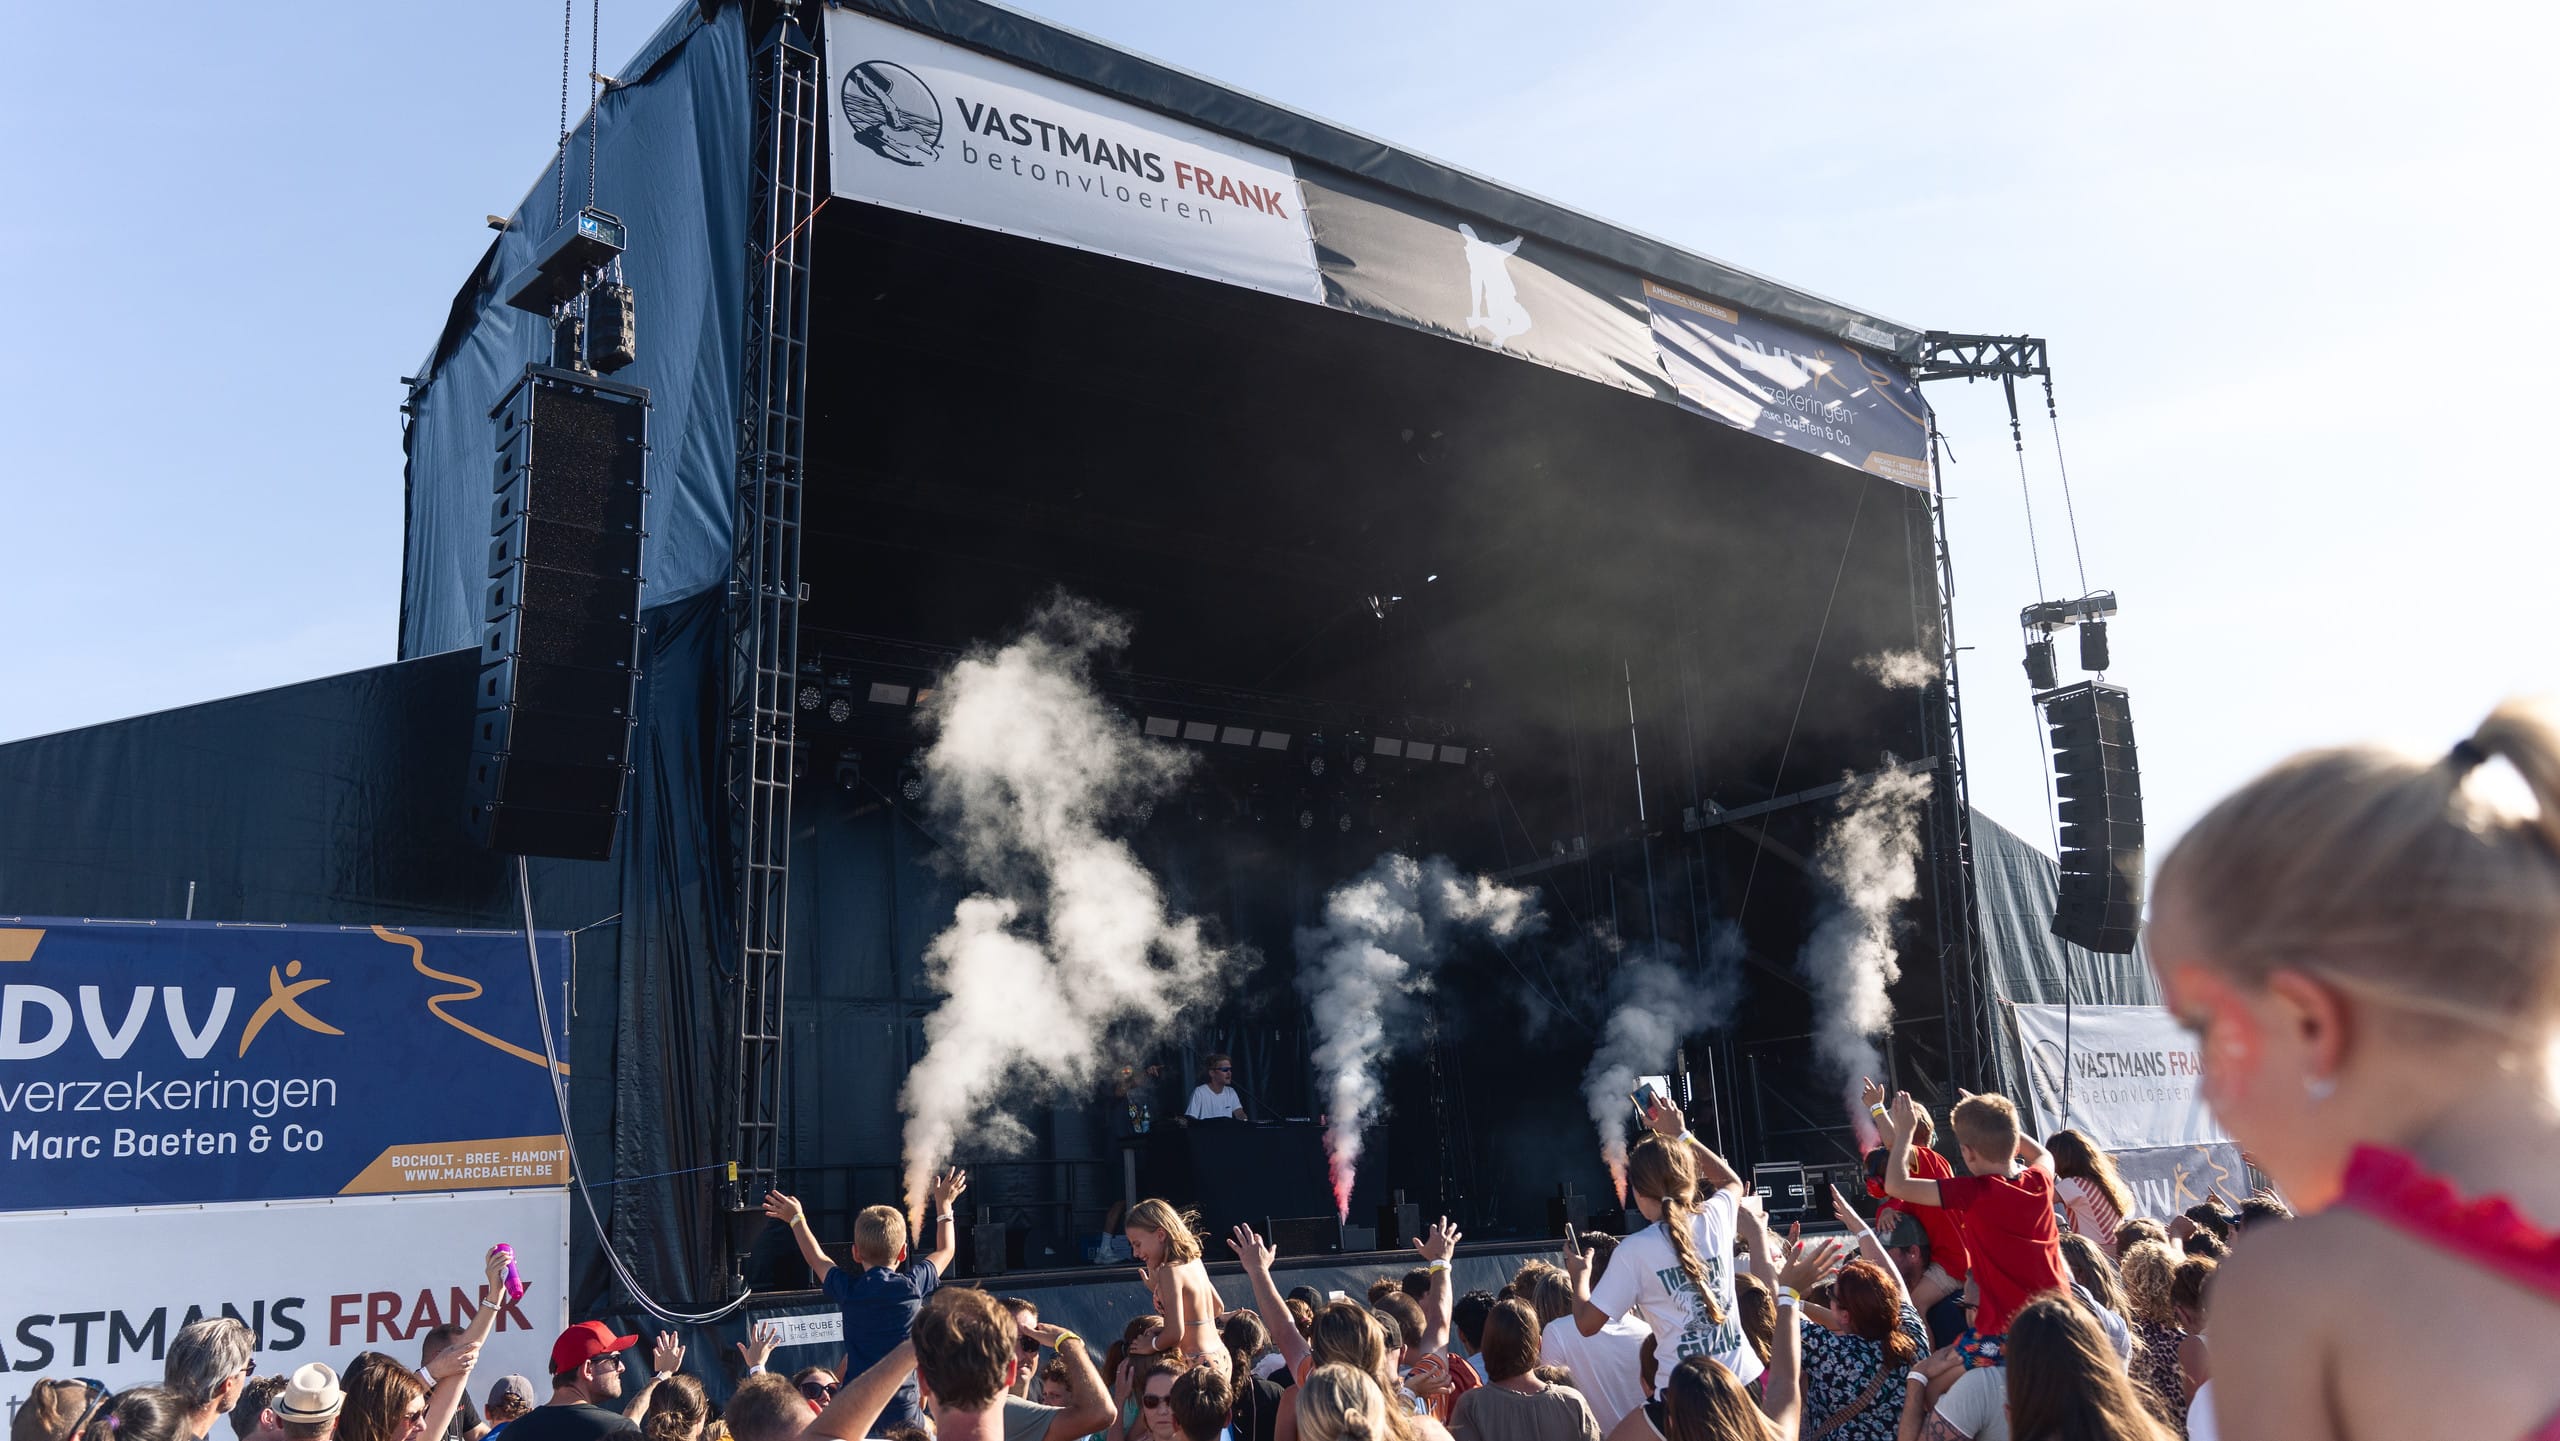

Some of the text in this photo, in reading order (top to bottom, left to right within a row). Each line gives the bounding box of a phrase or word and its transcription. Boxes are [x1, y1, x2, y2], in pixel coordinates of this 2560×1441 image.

[955, 96, 1289, 220] VASTMANS FRANK
[962, 140, 1213, 225] betonvloeren
[1750, 383, 1853, 425] rzekeringen
[1784, 412, 1824, 438] Baeten
[1825, 427, 1834, 441] &
[1836, 429, 1851, 446] Co
[0, 984, 236, 1060] DVV
[2073, 1051, 2167, 1079] VASTMANS
[0, 1070, 337, 1119] verzekeringen
[2081, 1087, 2191, 1105] betonvloeren
[11, 1123, 324, 1160] Marc Baeten & Co
[391, 1153, 454, 1168] BOCHOLT
[465, 1151, 500, 1165] BREE
[512, 1149, 565, 1163] HAMONT
[404, 1164, 552, 1182] WWW.MARCBAETEN.BE
[2131, 1178, 2170, 1217] VV
[788, 1322, 806, 1331] THE
[808, 1320, 833, 1331] CUBE
